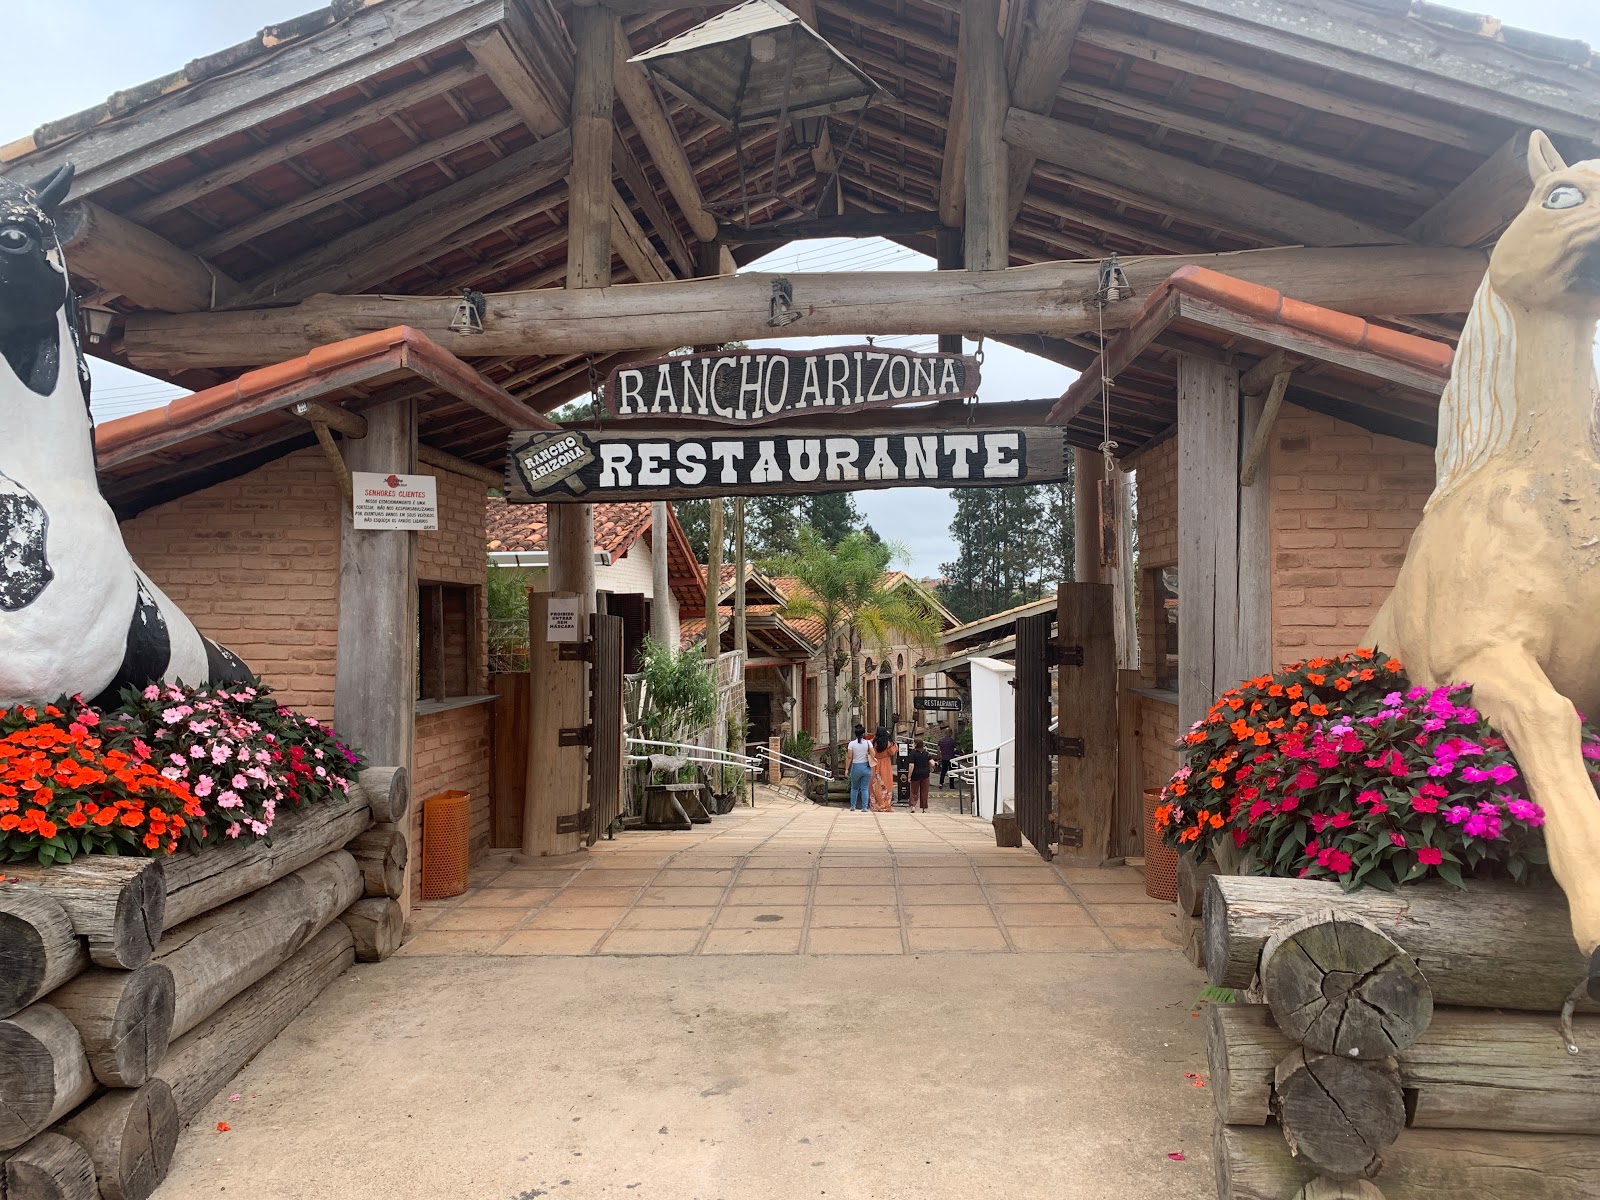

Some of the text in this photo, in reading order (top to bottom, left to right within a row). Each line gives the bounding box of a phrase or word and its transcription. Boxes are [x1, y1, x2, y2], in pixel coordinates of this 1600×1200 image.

[795, 352, 960, 408] ARIZONA
[524, 436, 577, 469] RANCHO
[530, 446, 586, 481] ARIZONA
[599, 433, 1020, 487] RESTAURANTE
[364, 489, 426, 498] SENHORES CLIENTES
